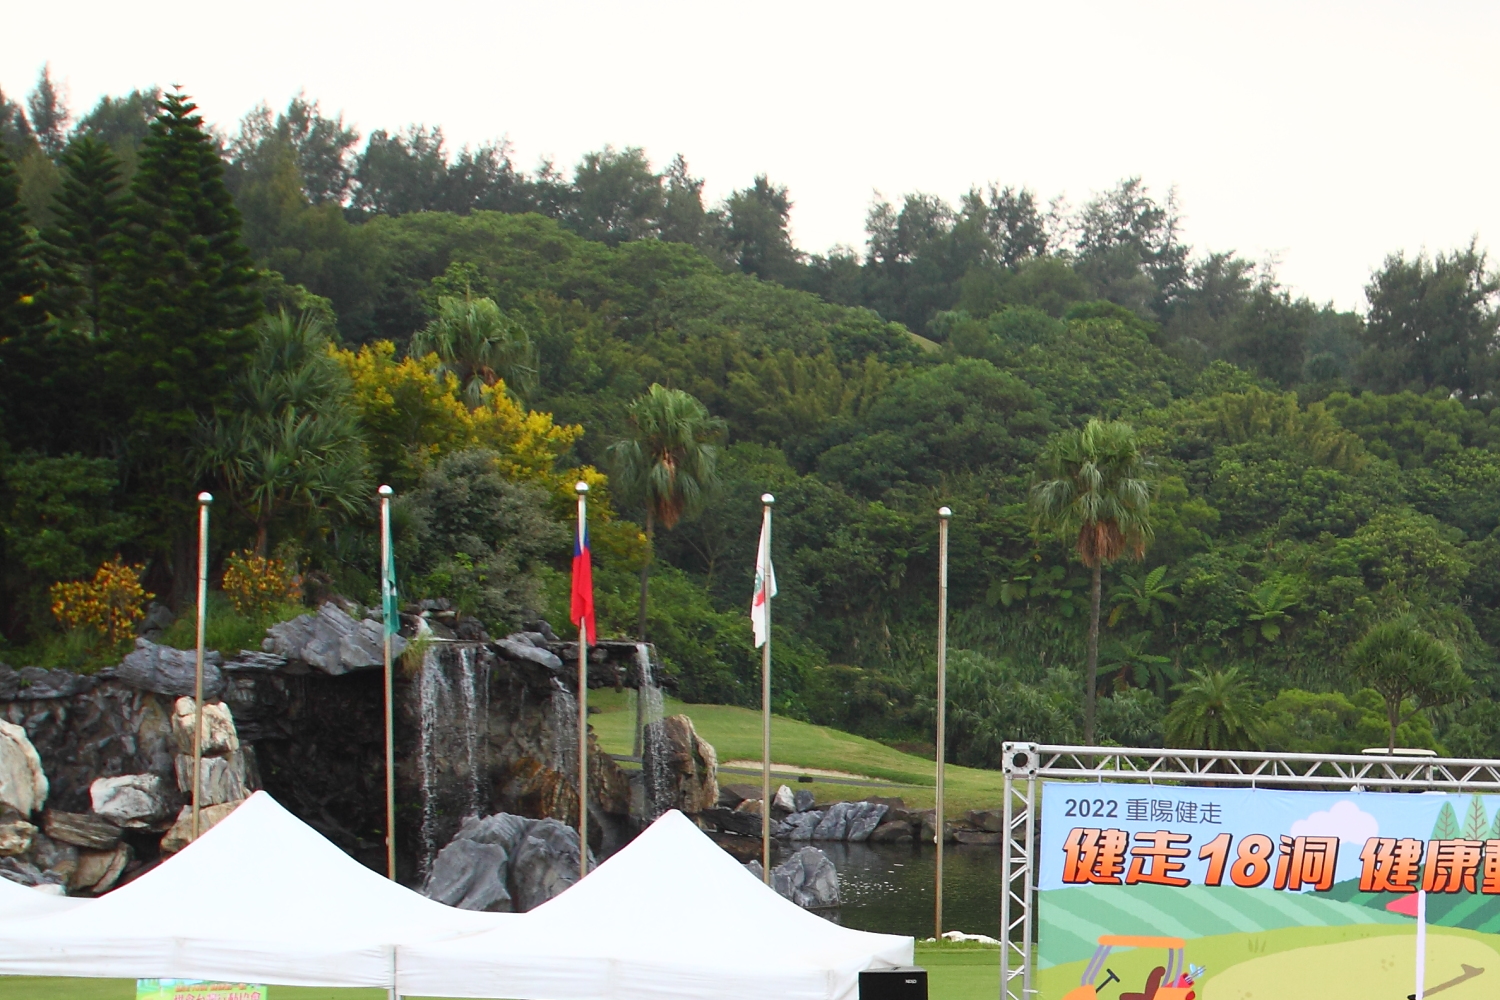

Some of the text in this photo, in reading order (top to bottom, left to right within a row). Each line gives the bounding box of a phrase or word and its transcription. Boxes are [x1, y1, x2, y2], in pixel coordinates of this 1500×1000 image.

[1064, 797, 1223, 825] 2022 重陽健走
[1061, 826, 1340, 892] 健走18洞
